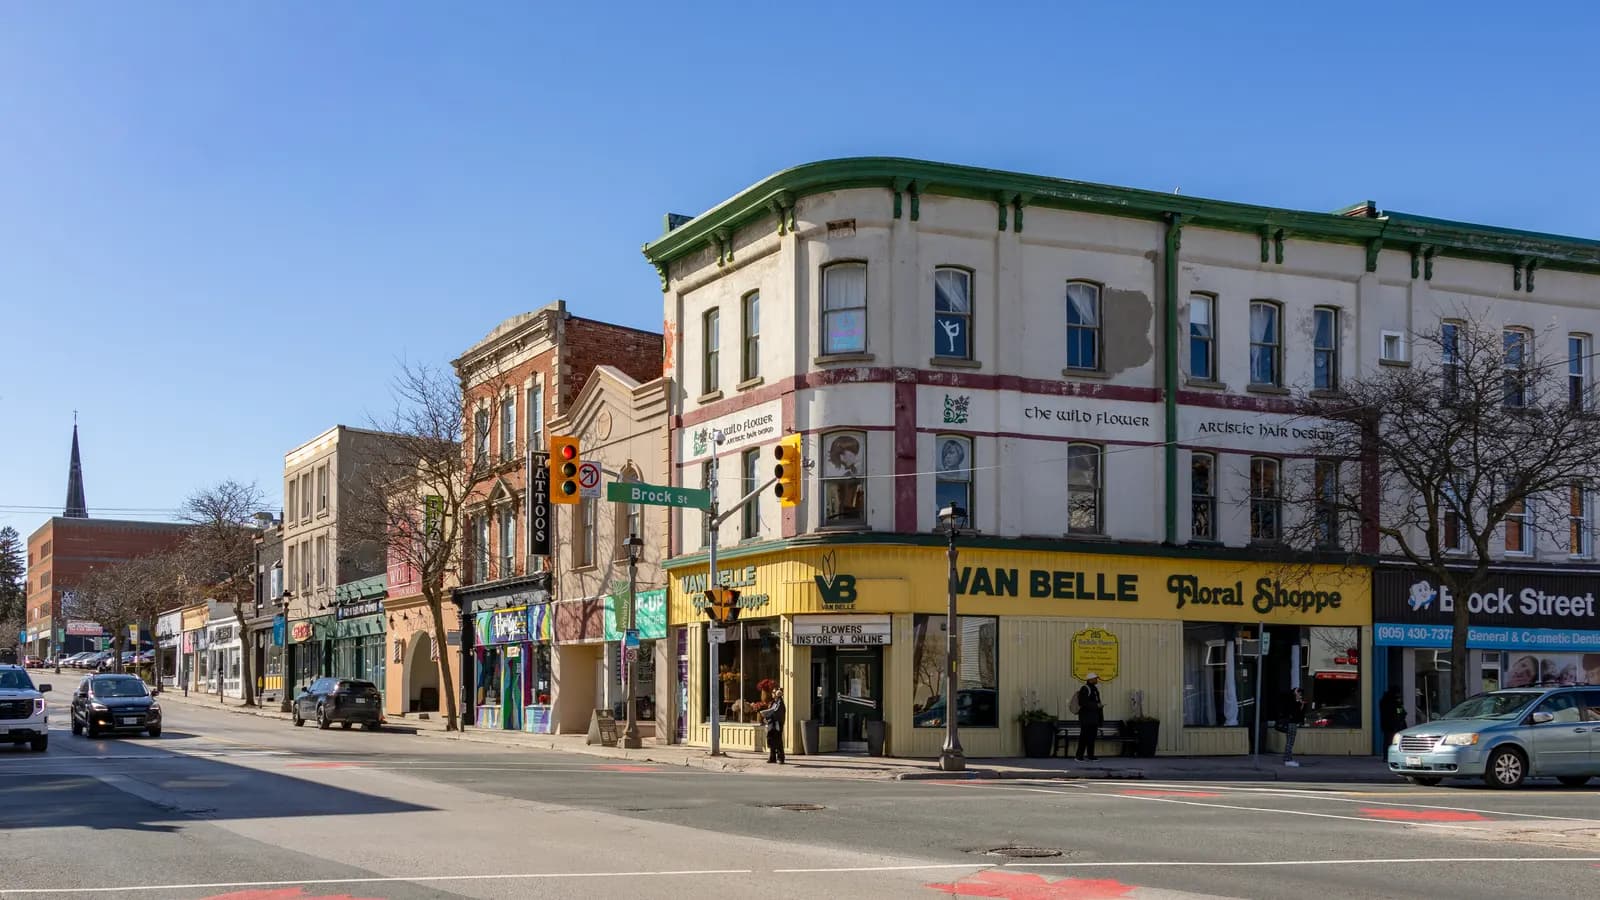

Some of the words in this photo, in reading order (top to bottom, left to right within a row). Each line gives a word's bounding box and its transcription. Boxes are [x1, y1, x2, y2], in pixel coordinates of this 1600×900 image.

[535, 454, 547, 542] TATTOOS
[631, 487, 672, 503] Brock
[681, 573, 708, 594] VAN
[715, 565, 757, 589] ELLE
[814, 574, 857, 604] VB
[954, 566, 1018, 598] VAN
[1029, 569, 1139, 602] BELLE
[1167, 574, 1244, 609] Floral
[1252, 577, 1342, 614] Shoppe
[1439, 585, 1514, 615] Bock
[1519, 587, 1595, 617] Street
[796, 635, 833, 644] INSTORE
[839, 635, 845, 644] &
[851, 635, 883, 644] ONLINE
[821, 625, 862, 634] FLOWERS
[1378, 627, 1405, 640] (905)
[1468, 631, 1509, 643] General
[1511, 632, 1519, 643] &
[1521, 631, 1571, 644] Cosmetic
